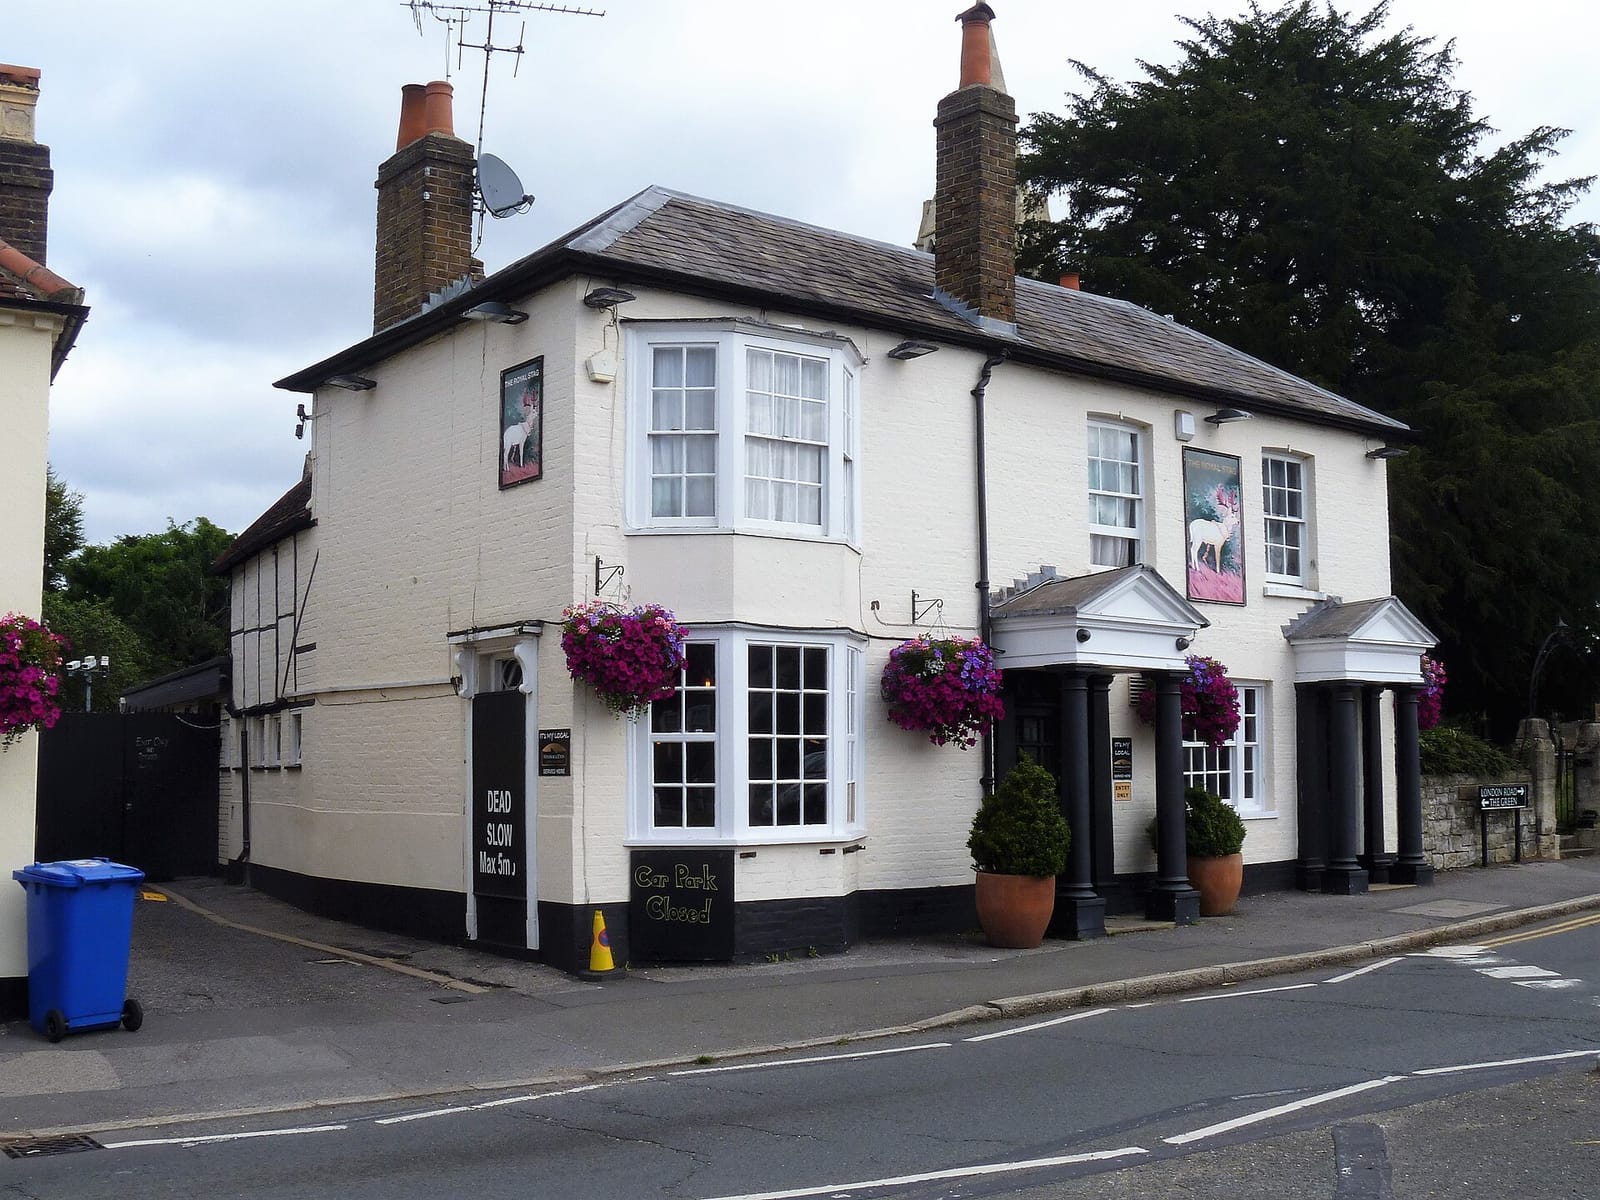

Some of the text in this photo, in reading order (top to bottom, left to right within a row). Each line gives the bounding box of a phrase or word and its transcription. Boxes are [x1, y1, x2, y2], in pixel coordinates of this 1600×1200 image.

[487, 790, 512, 813] DEAD
[1480, 787, 1518, 798] LONDON ROAD
[1490, 797, 1518, 807] THE GREEN
[486, 822, 513, 847] SLOW
[479, 851, 497, 874] Max
[634, 863, 718, 891] Car Park
[645, 895, 713, 924] Closed
